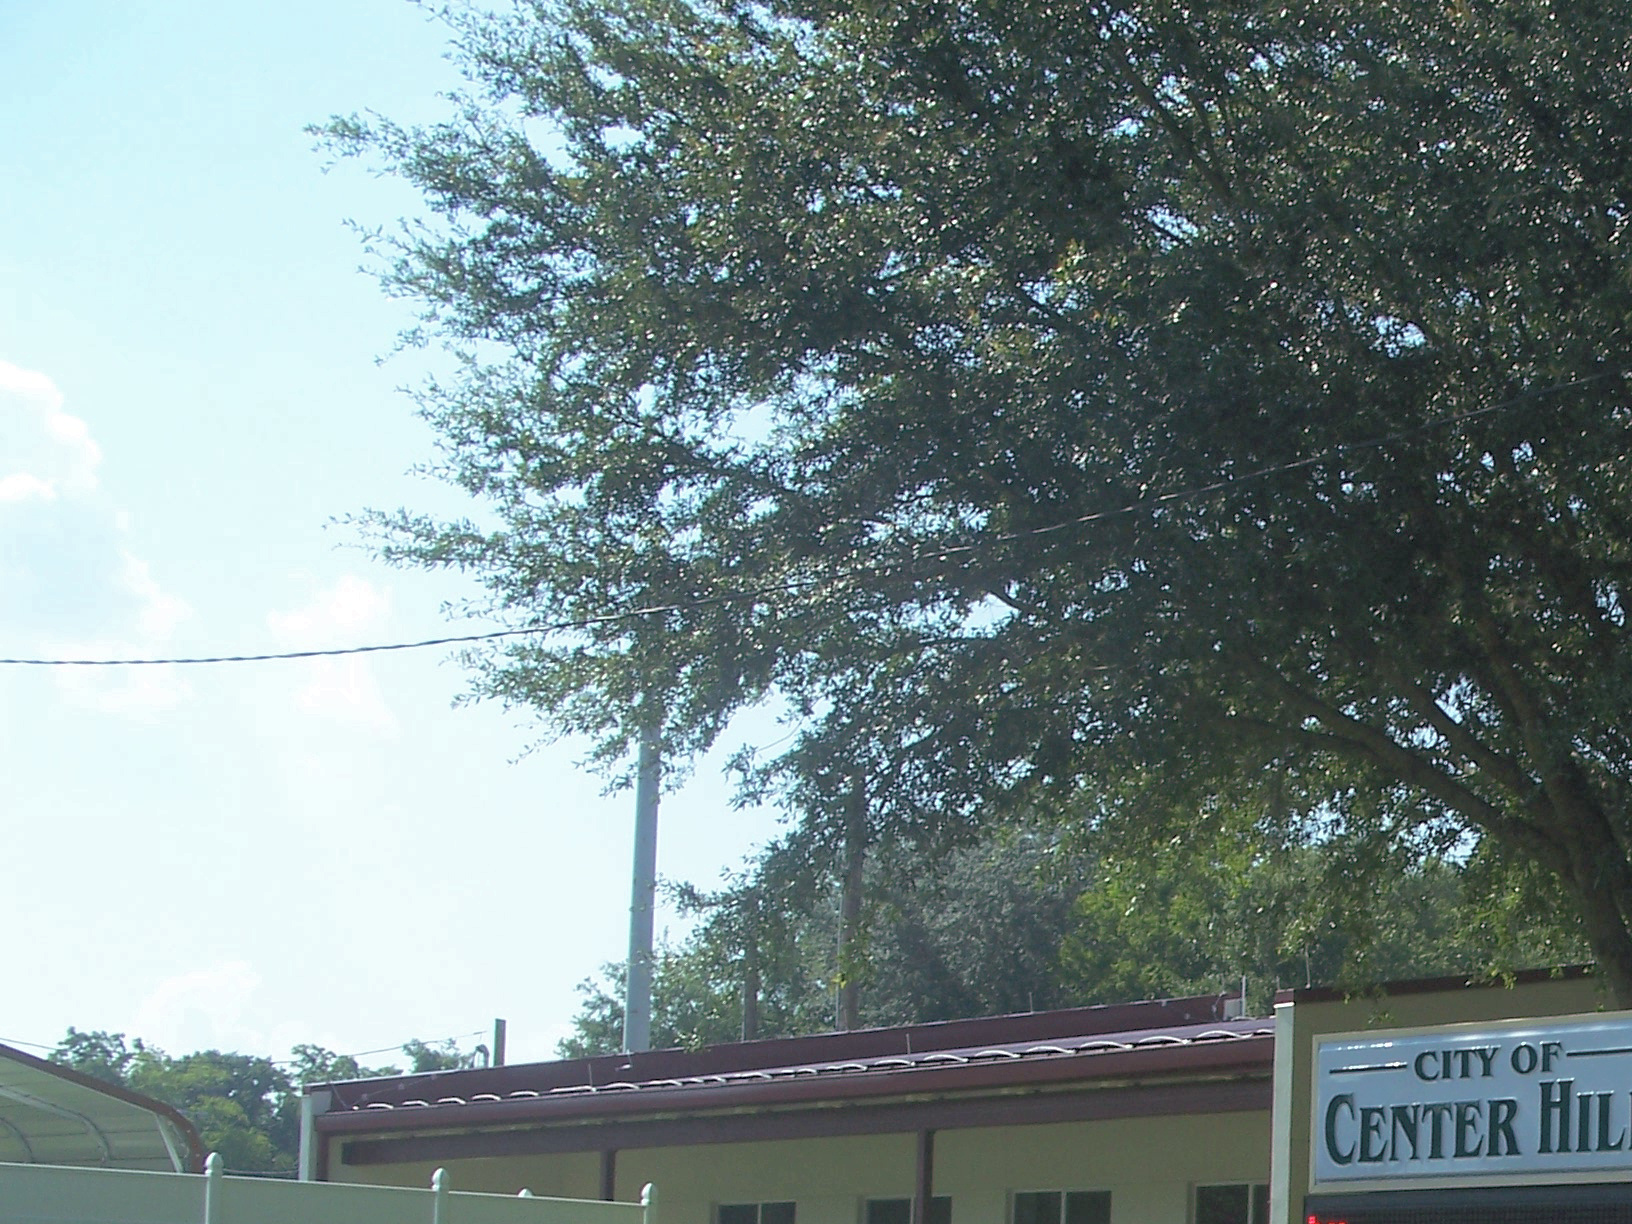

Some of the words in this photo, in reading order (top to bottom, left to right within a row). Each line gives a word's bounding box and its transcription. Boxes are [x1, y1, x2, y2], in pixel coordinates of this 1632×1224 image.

[1414, 1045, 1500, 1081] CITY
[1511, 1040, 1563, 1074] OF
[1325, 1092, 1522, 1166] CENTER
